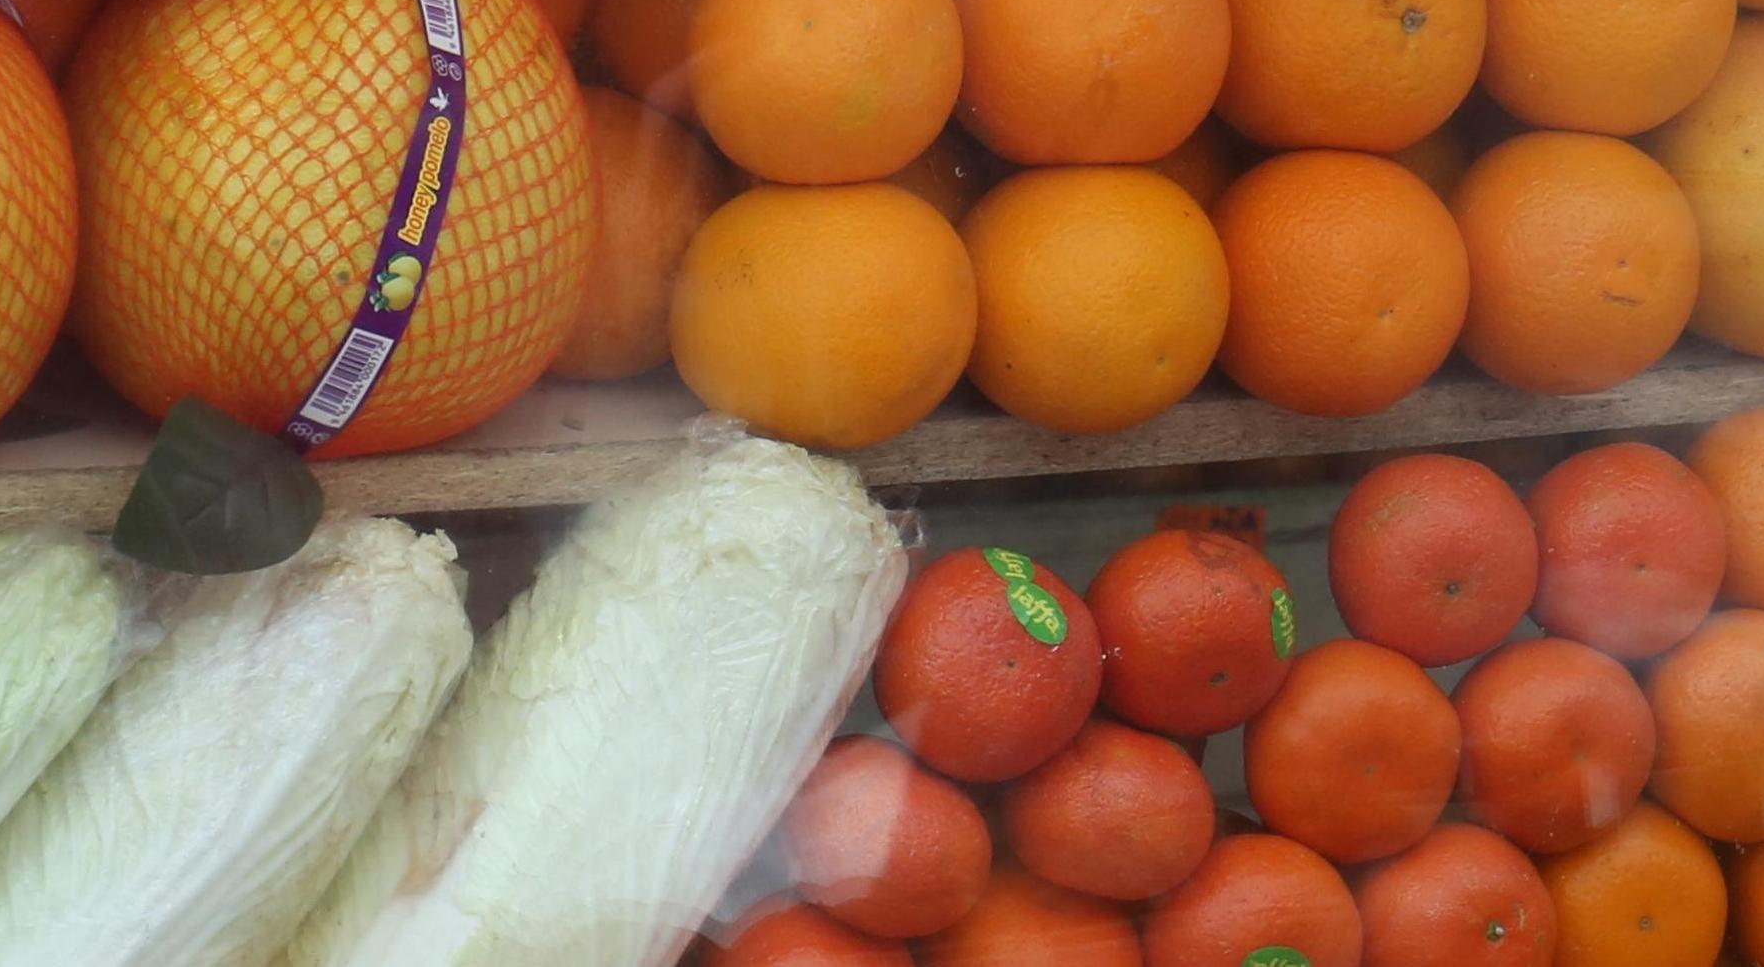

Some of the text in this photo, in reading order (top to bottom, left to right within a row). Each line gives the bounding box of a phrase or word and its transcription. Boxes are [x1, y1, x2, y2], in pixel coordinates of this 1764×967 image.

[398, 116, 451, 246] honey pomelo
[360, 342, 387, 381] 000172
